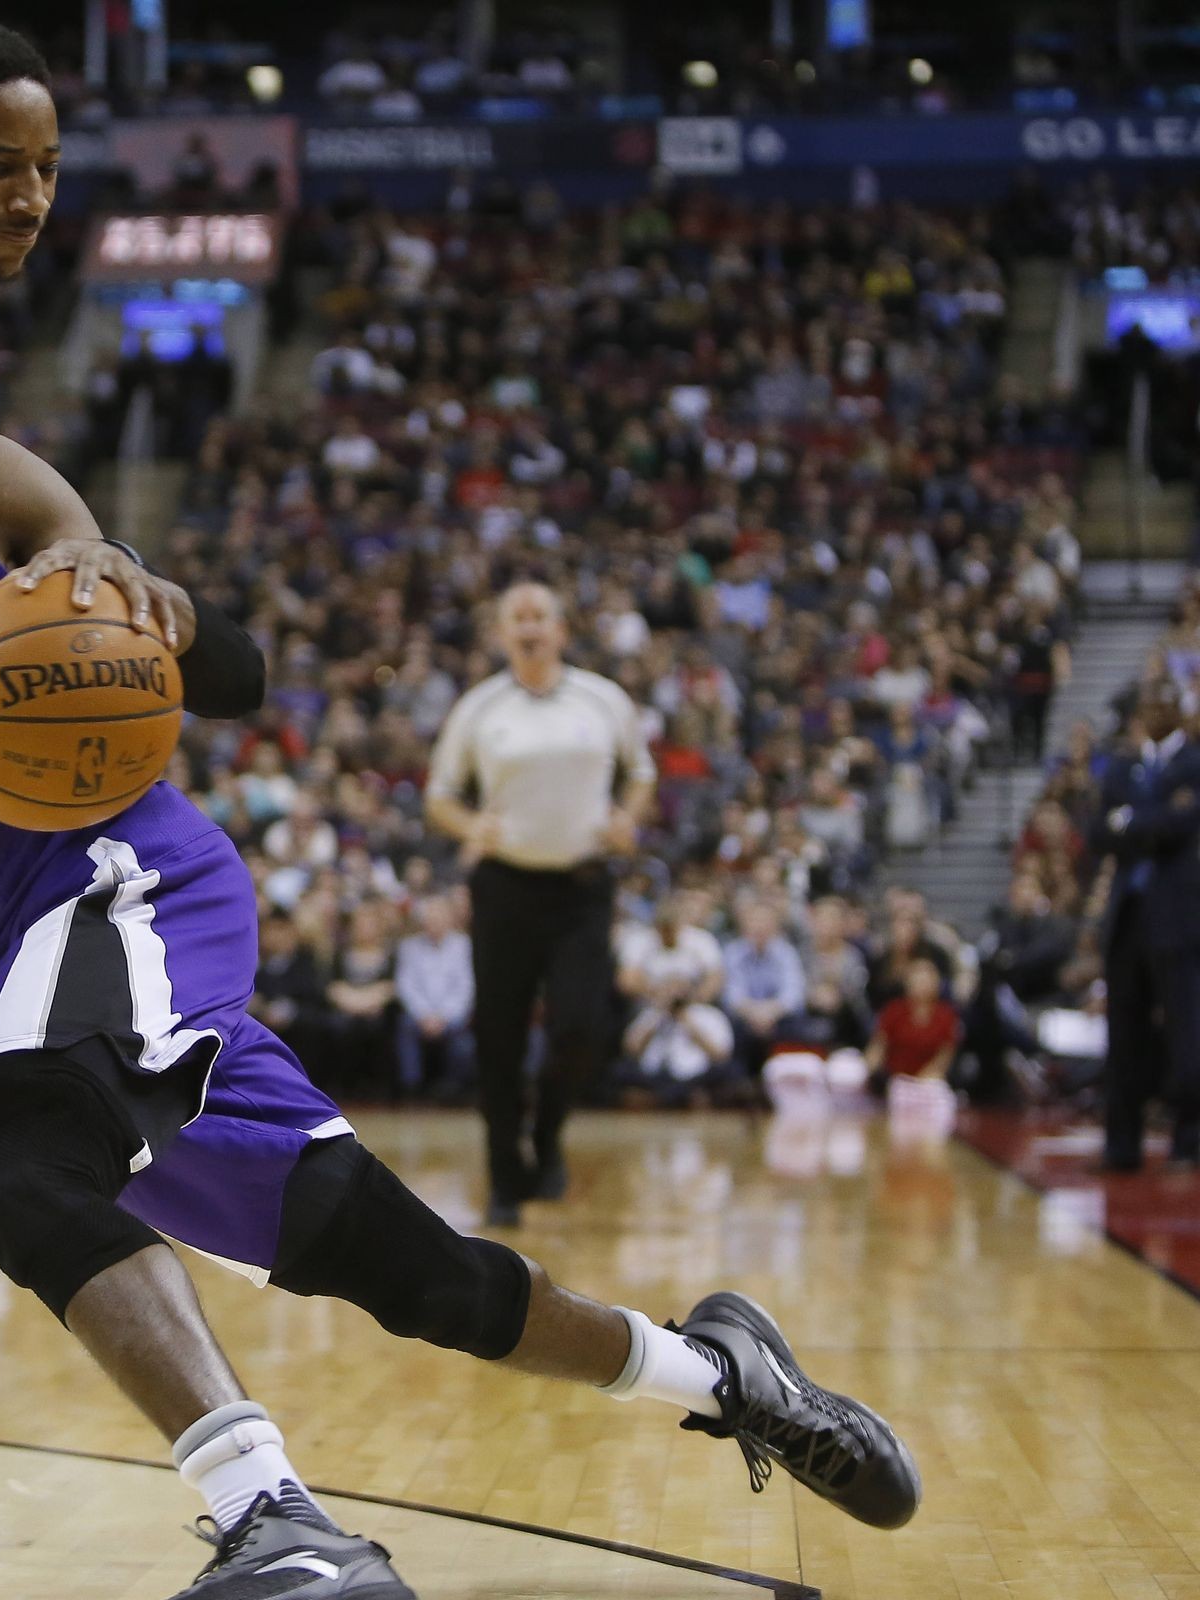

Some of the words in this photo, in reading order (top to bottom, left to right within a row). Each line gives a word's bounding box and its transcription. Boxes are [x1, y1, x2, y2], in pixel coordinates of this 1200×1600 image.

[306, 127, 493, 167] BASKETBALL
[1023, 117, 1106, 161] GO
[1117, 115, 1200, 158] LE
